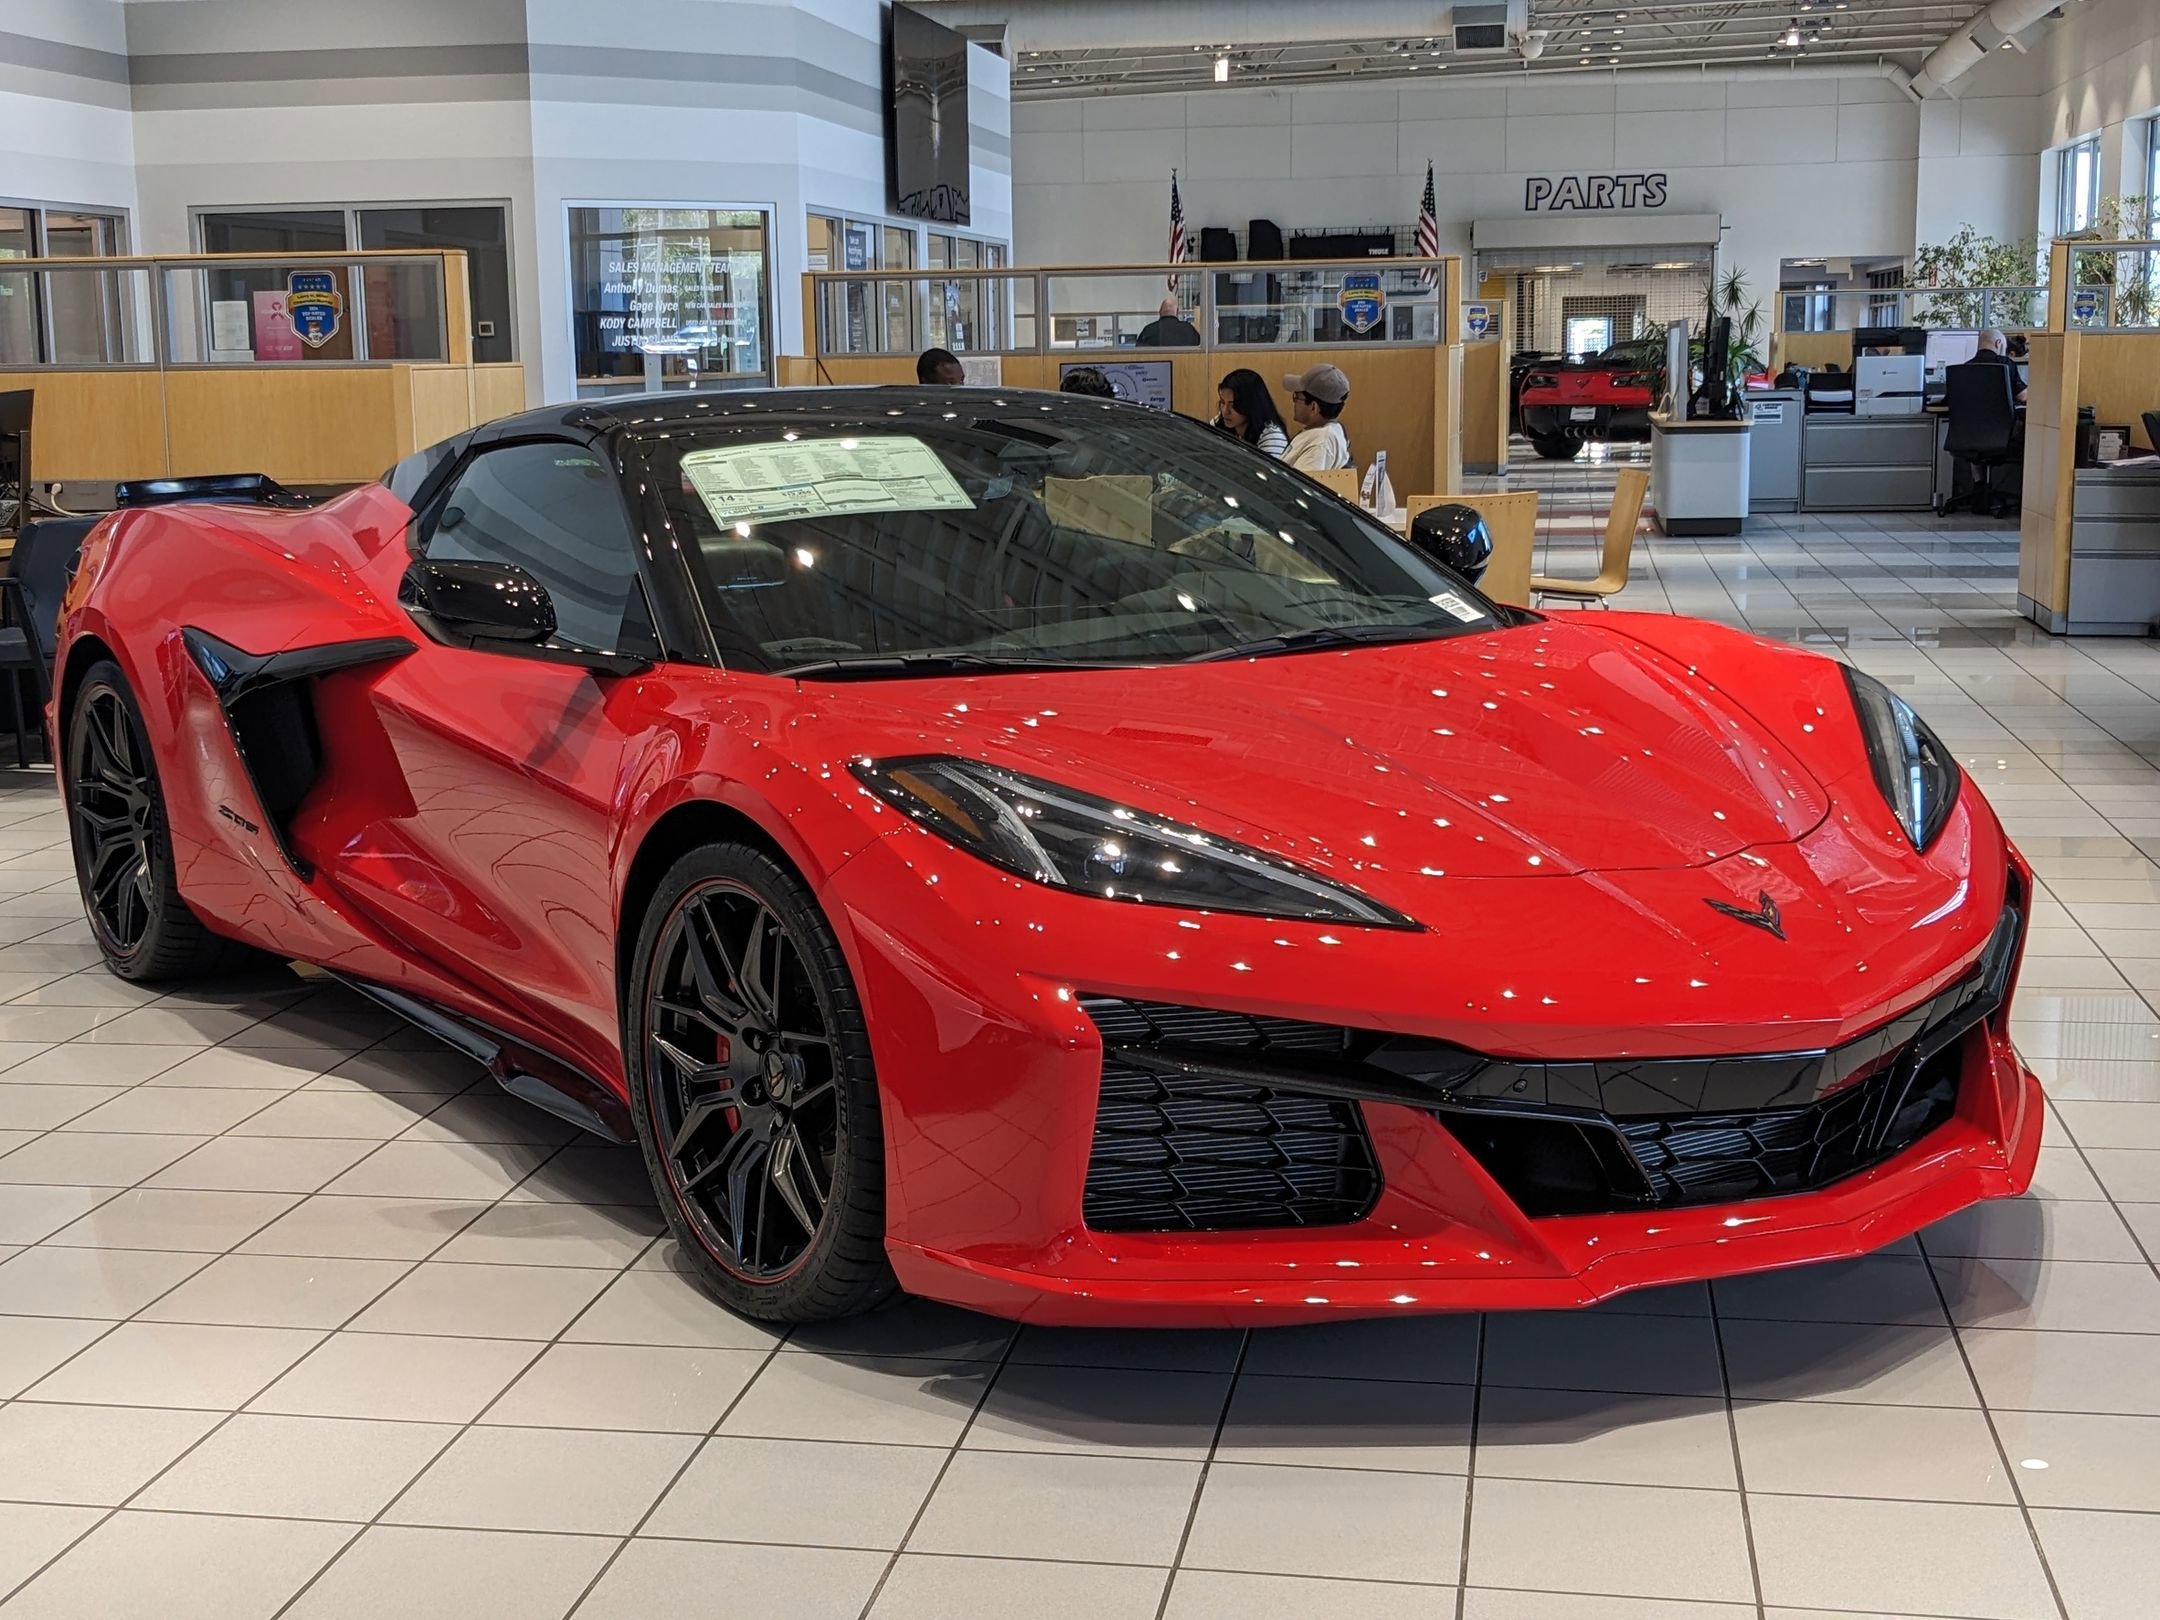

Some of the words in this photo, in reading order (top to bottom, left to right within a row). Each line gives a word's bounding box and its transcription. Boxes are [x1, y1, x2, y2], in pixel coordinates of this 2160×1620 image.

[1525, 173, 1667, 211] PARTS
[609, 262, 638, 274] SALES
[640, 262, 706, 273] MANAGEMENT
[604, 282, 643, 296] Anthony
[645, 283, 678, 294] Dumas
[629, 300, 654, 313] Gage
[600, 318, 625, 329] KODY
[627, 318, 678, 329] CAMPBELL
